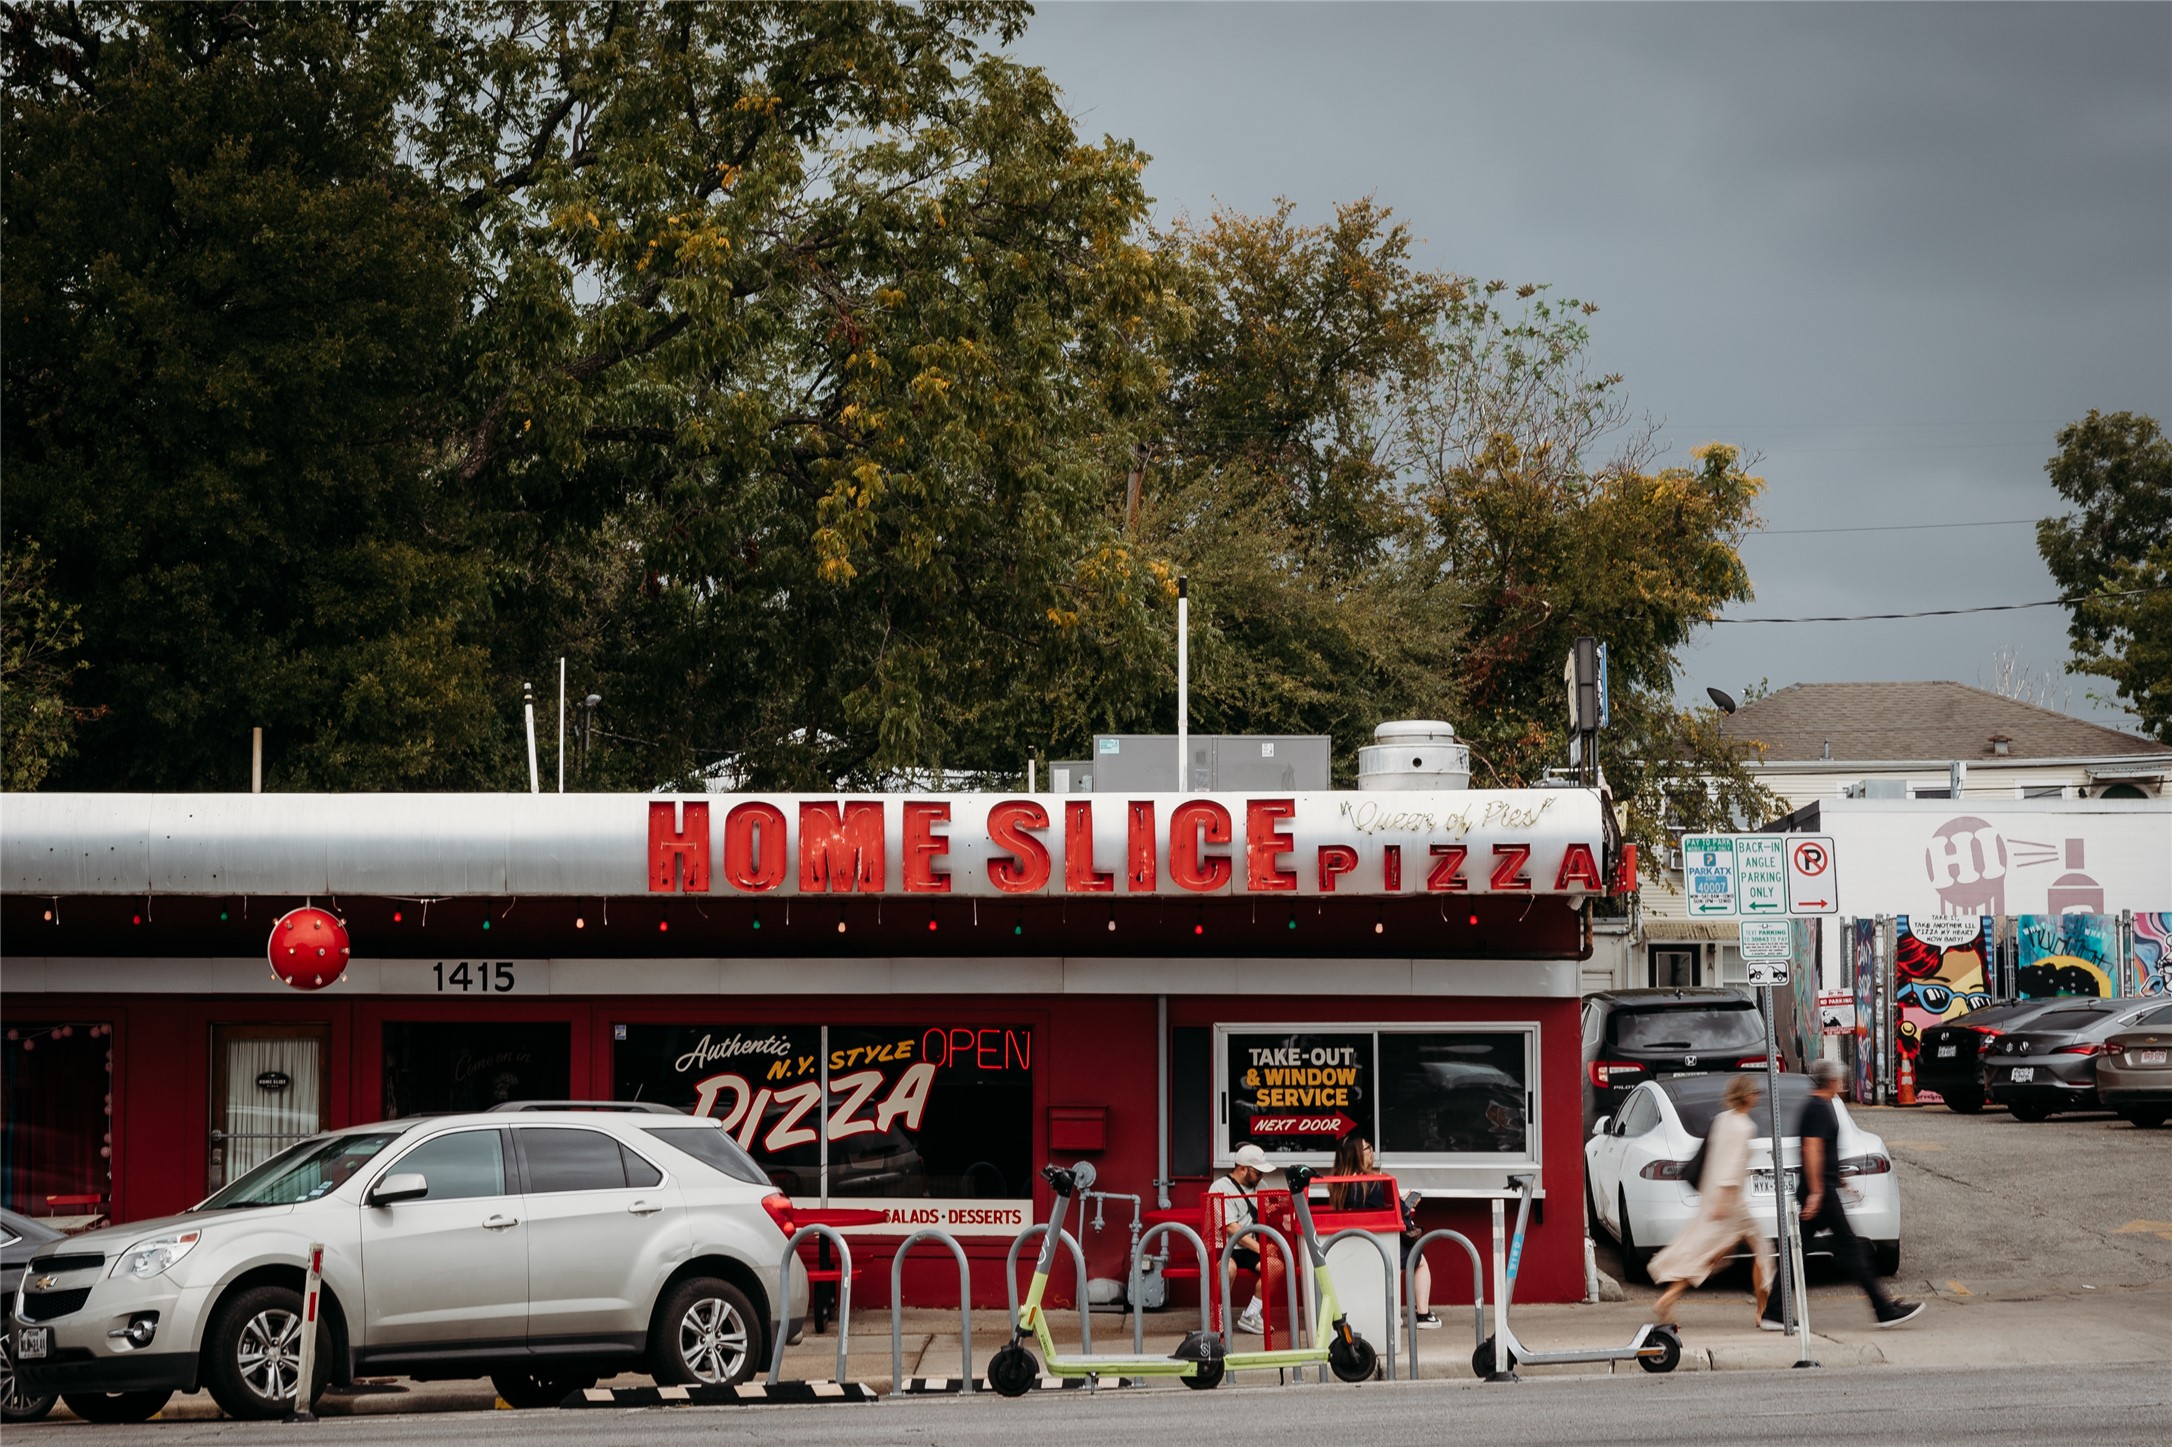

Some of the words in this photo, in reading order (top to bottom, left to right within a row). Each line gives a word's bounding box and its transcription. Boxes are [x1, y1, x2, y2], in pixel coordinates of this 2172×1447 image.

[1447, 803, 1472, 840] of
[648, 799, 951, 893] HOME
[987, 799, 1297, 893] SLICE
[1686, 838, 1700, 847] PAY
[1702, 838, 1711, 846] TO
[1712, 838, 1731, 846] PARK
[1739, 841, 1781, 853] BACK-IN
[1319, 843, 1602, 892] PIZZA
[1689, 867, 1713, 876] PARK
[1714, 867, 1732, 876] ATX
[1745, 857, 1776, 868] ANGLE
[1698, 881, 1726, 893] 40007
[1741, 872, 1782, 883] PARKING
[1750, 887, 1774, 898] ONLY
[433, 961, 515, 992] 1415
[1828, 997, 1853, 1005] PARKING
[675, 1033, 791, 1072] Authentic
[922, 1027, 1031, 1070] OPEN
[1248, 1047, 1354, 1066] TAKE-OUT
[455, 1055, 493, 1081] Come
[496, 1051, 514, 1063] on
[766, 1055, 816, 1081] N.Y.
[829, 1040, 915, 1070] STYLE
[1246, 1068, 1261, 1086] &
[1264, 1068, 1357, 1086] WINDOW
[693, 1061, 937, 1153] PIZZA
[1256, 1088, 1349, 1107] SERVICE
[1254, 1118, 1297, 1132] NEXT
[1298, 1118, 1342, 1132] DOOR
[883, 1209, 939, 1224] SALADS
[948, 1209, 1022, 1224] DESSERTS
[1509, 1241, 1521, 1270] BIRD
